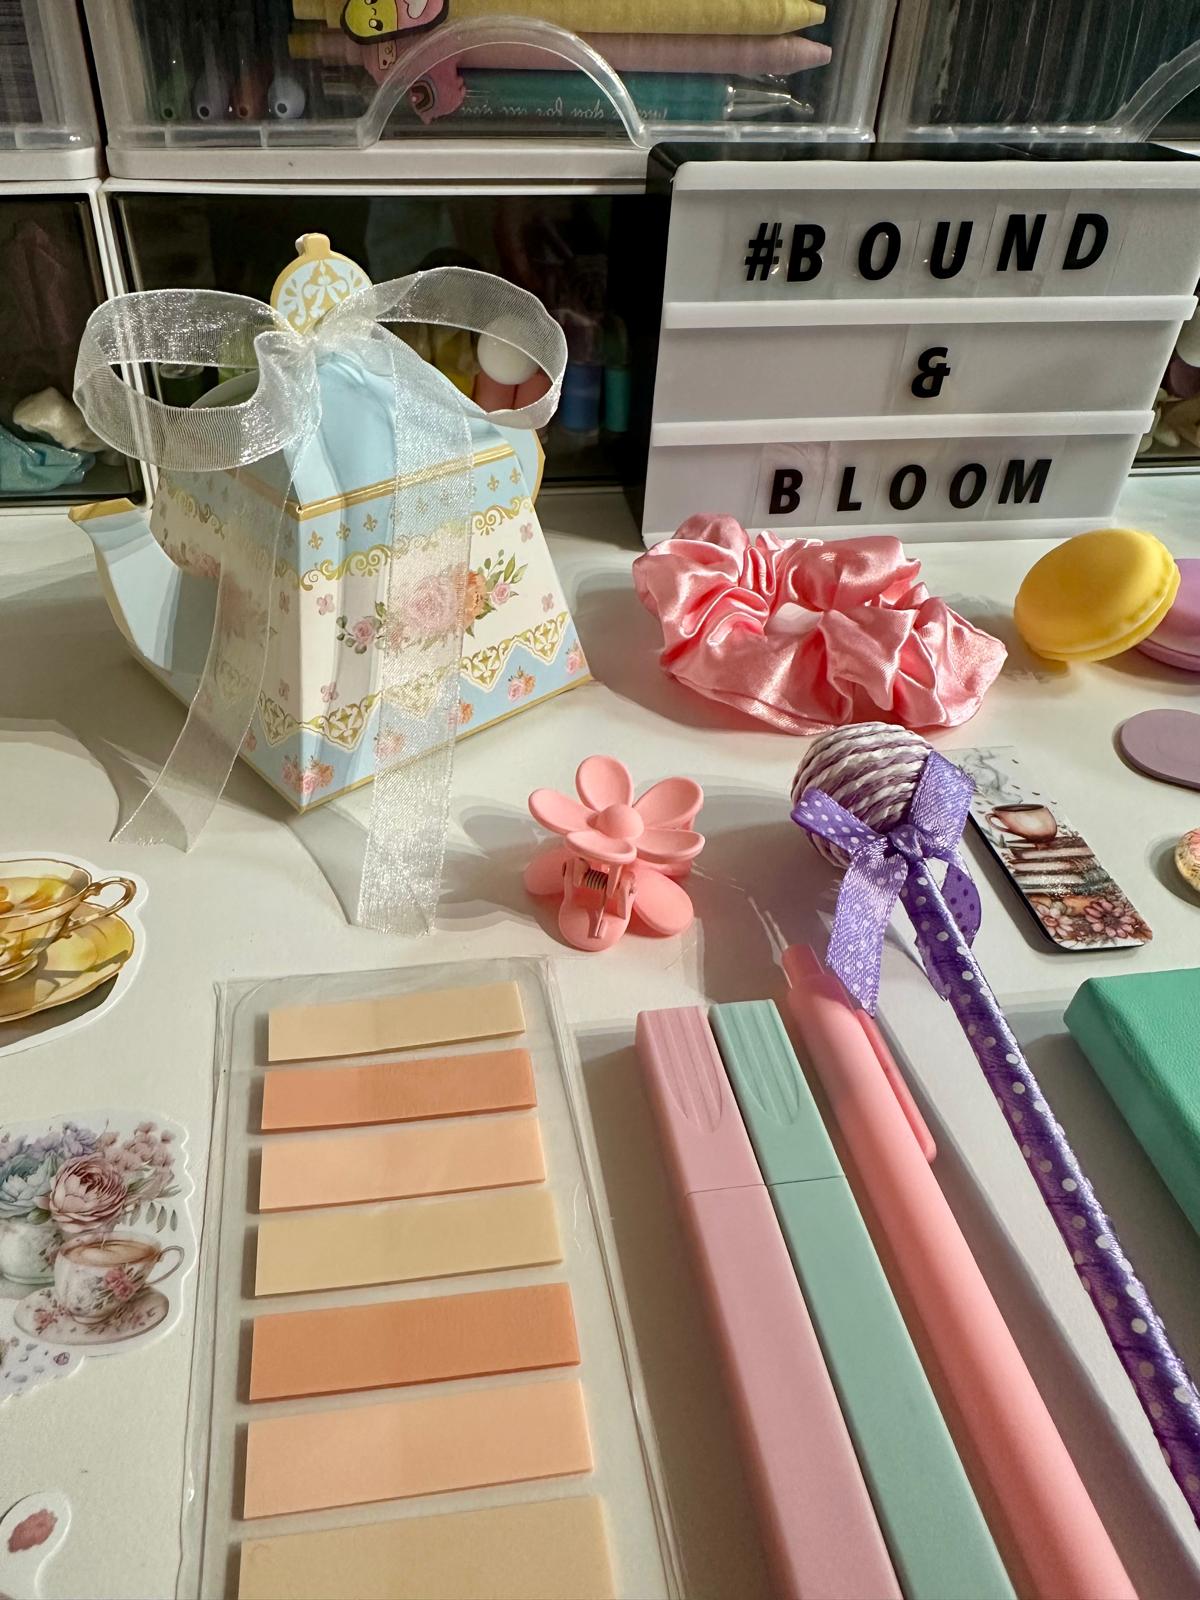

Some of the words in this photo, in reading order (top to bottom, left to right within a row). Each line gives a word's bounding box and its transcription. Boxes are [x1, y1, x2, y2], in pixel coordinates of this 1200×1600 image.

[744, 213, 1109, 282] #BOUND
[911, 347, 951, 399] &
[768, 459, 1053, 515] BLOOM
